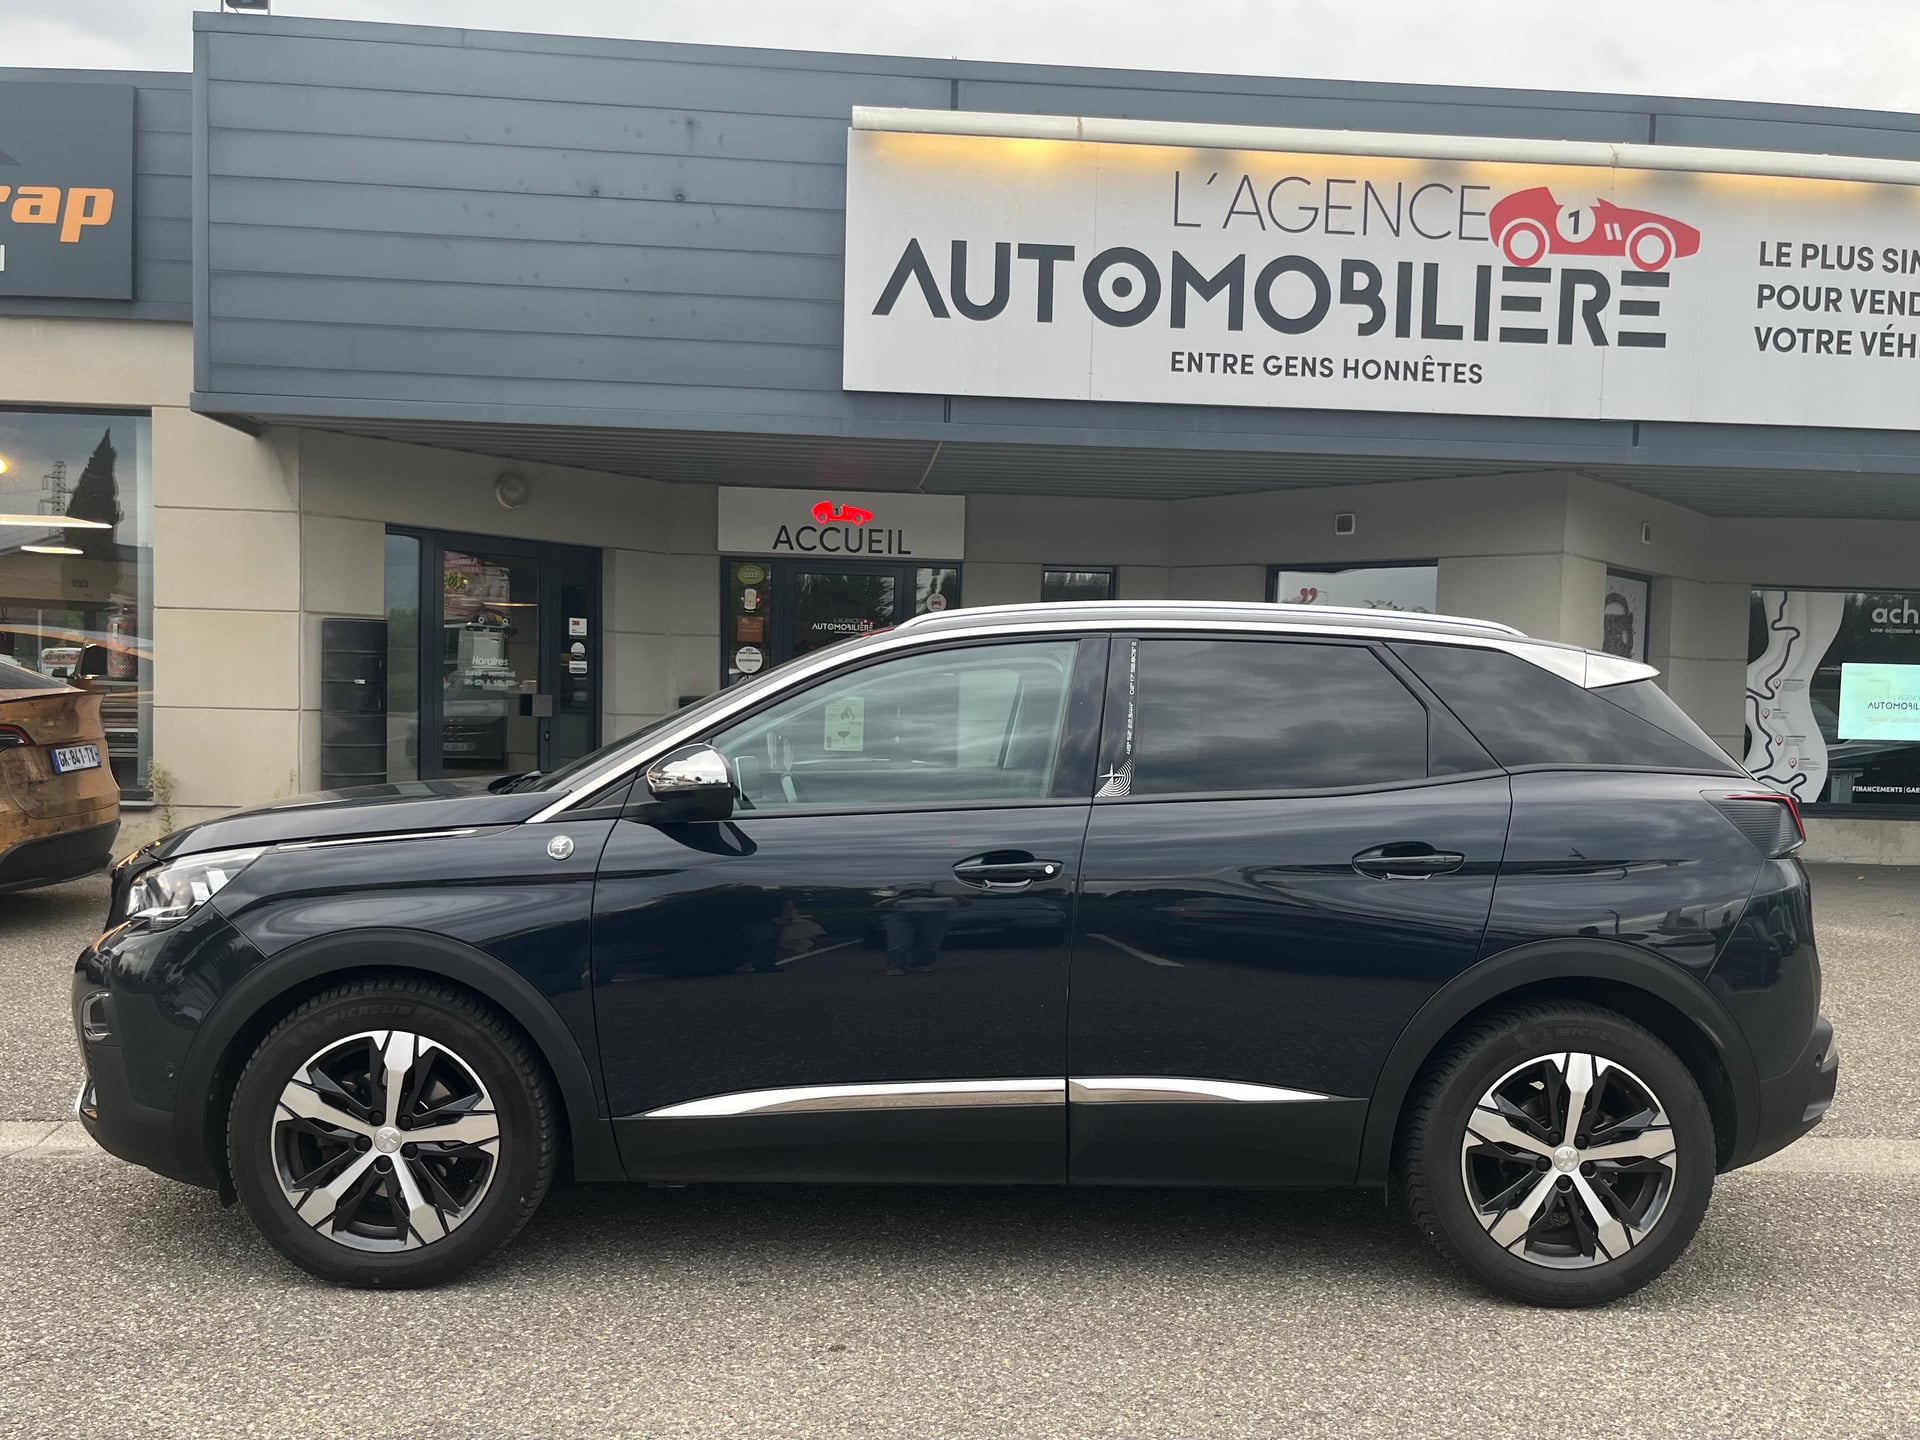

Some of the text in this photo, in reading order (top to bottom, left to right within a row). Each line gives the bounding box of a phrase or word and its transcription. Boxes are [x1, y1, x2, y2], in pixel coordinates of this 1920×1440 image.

[1759, 241, 1792, 267] LE
[1801, 243, 1874, 272] PLUS
[1757, 284, 1843, 312] POUR
[1754, 323, 1920, 358] VOTRE VÉH
[1170, 351, 1484, 385] ENTRE GENS HONNÊTES
[772, 525, 912, 555] ACCUEIL
[1872, 599, 1919, 624] ach
[1852, 785, 1903, 793] FINANCEMENTS
